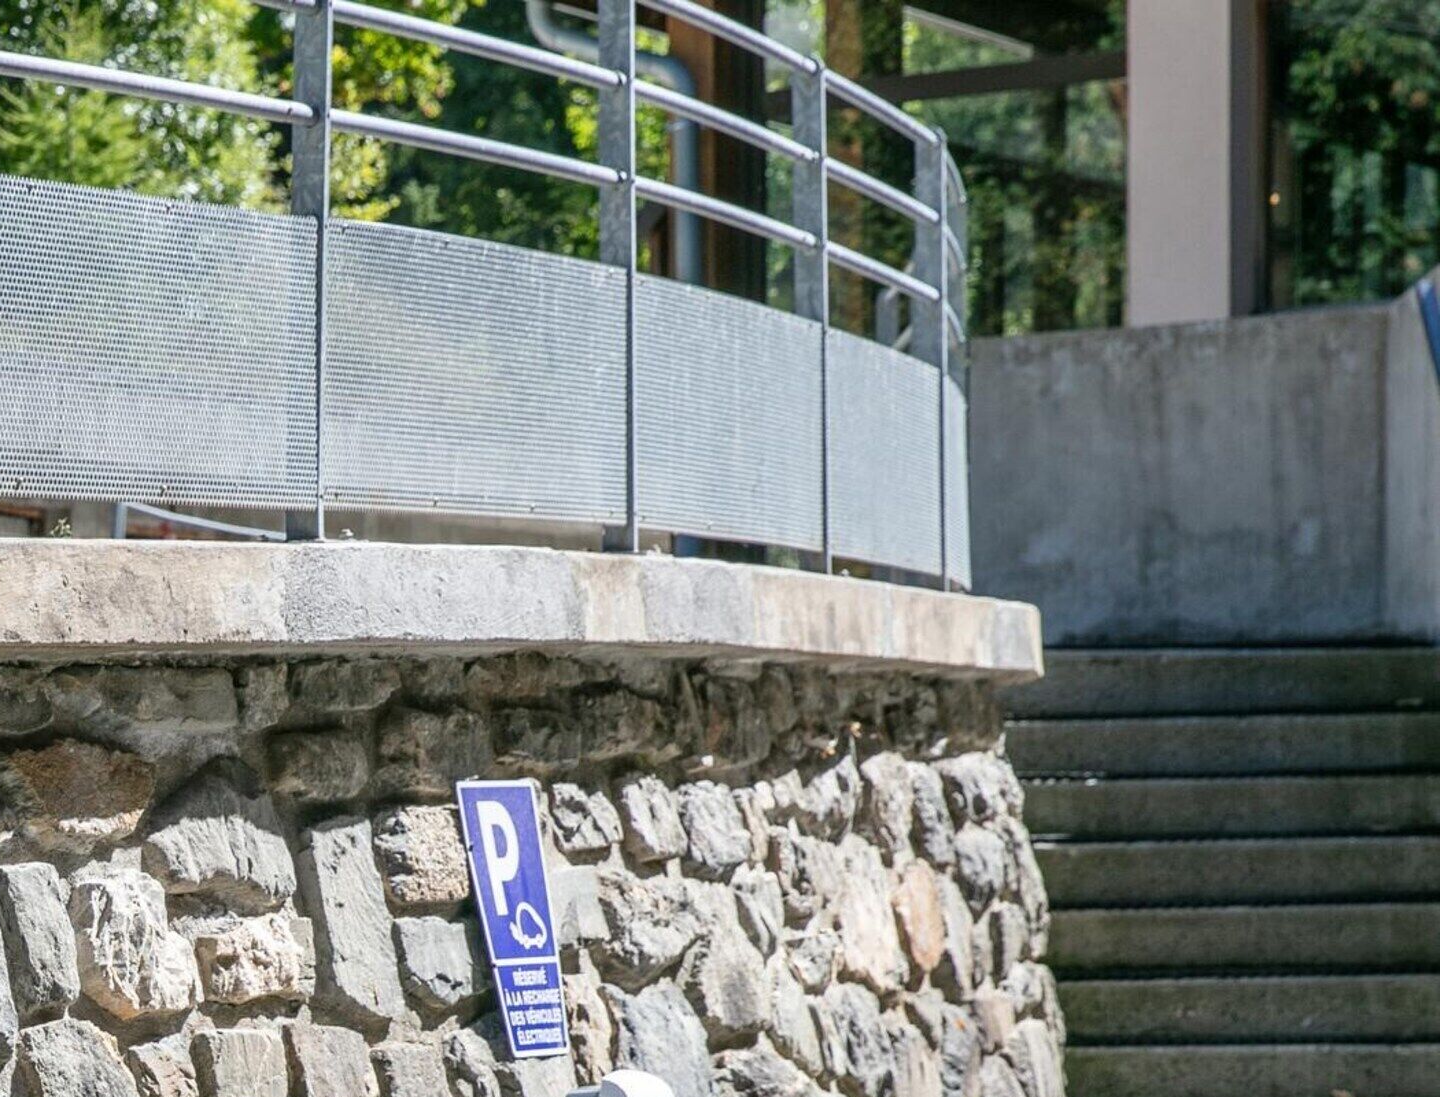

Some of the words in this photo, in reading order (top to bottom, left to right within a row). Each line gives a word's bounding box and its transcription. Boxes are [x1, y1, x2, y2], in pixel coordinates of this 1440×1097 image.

[476, 800, 520, 916] P
[512, 990, 523, 1006] LA
[509, 1010, 526, 1026] DES
[525, 1006, 562, 1024] VÉHICULES
